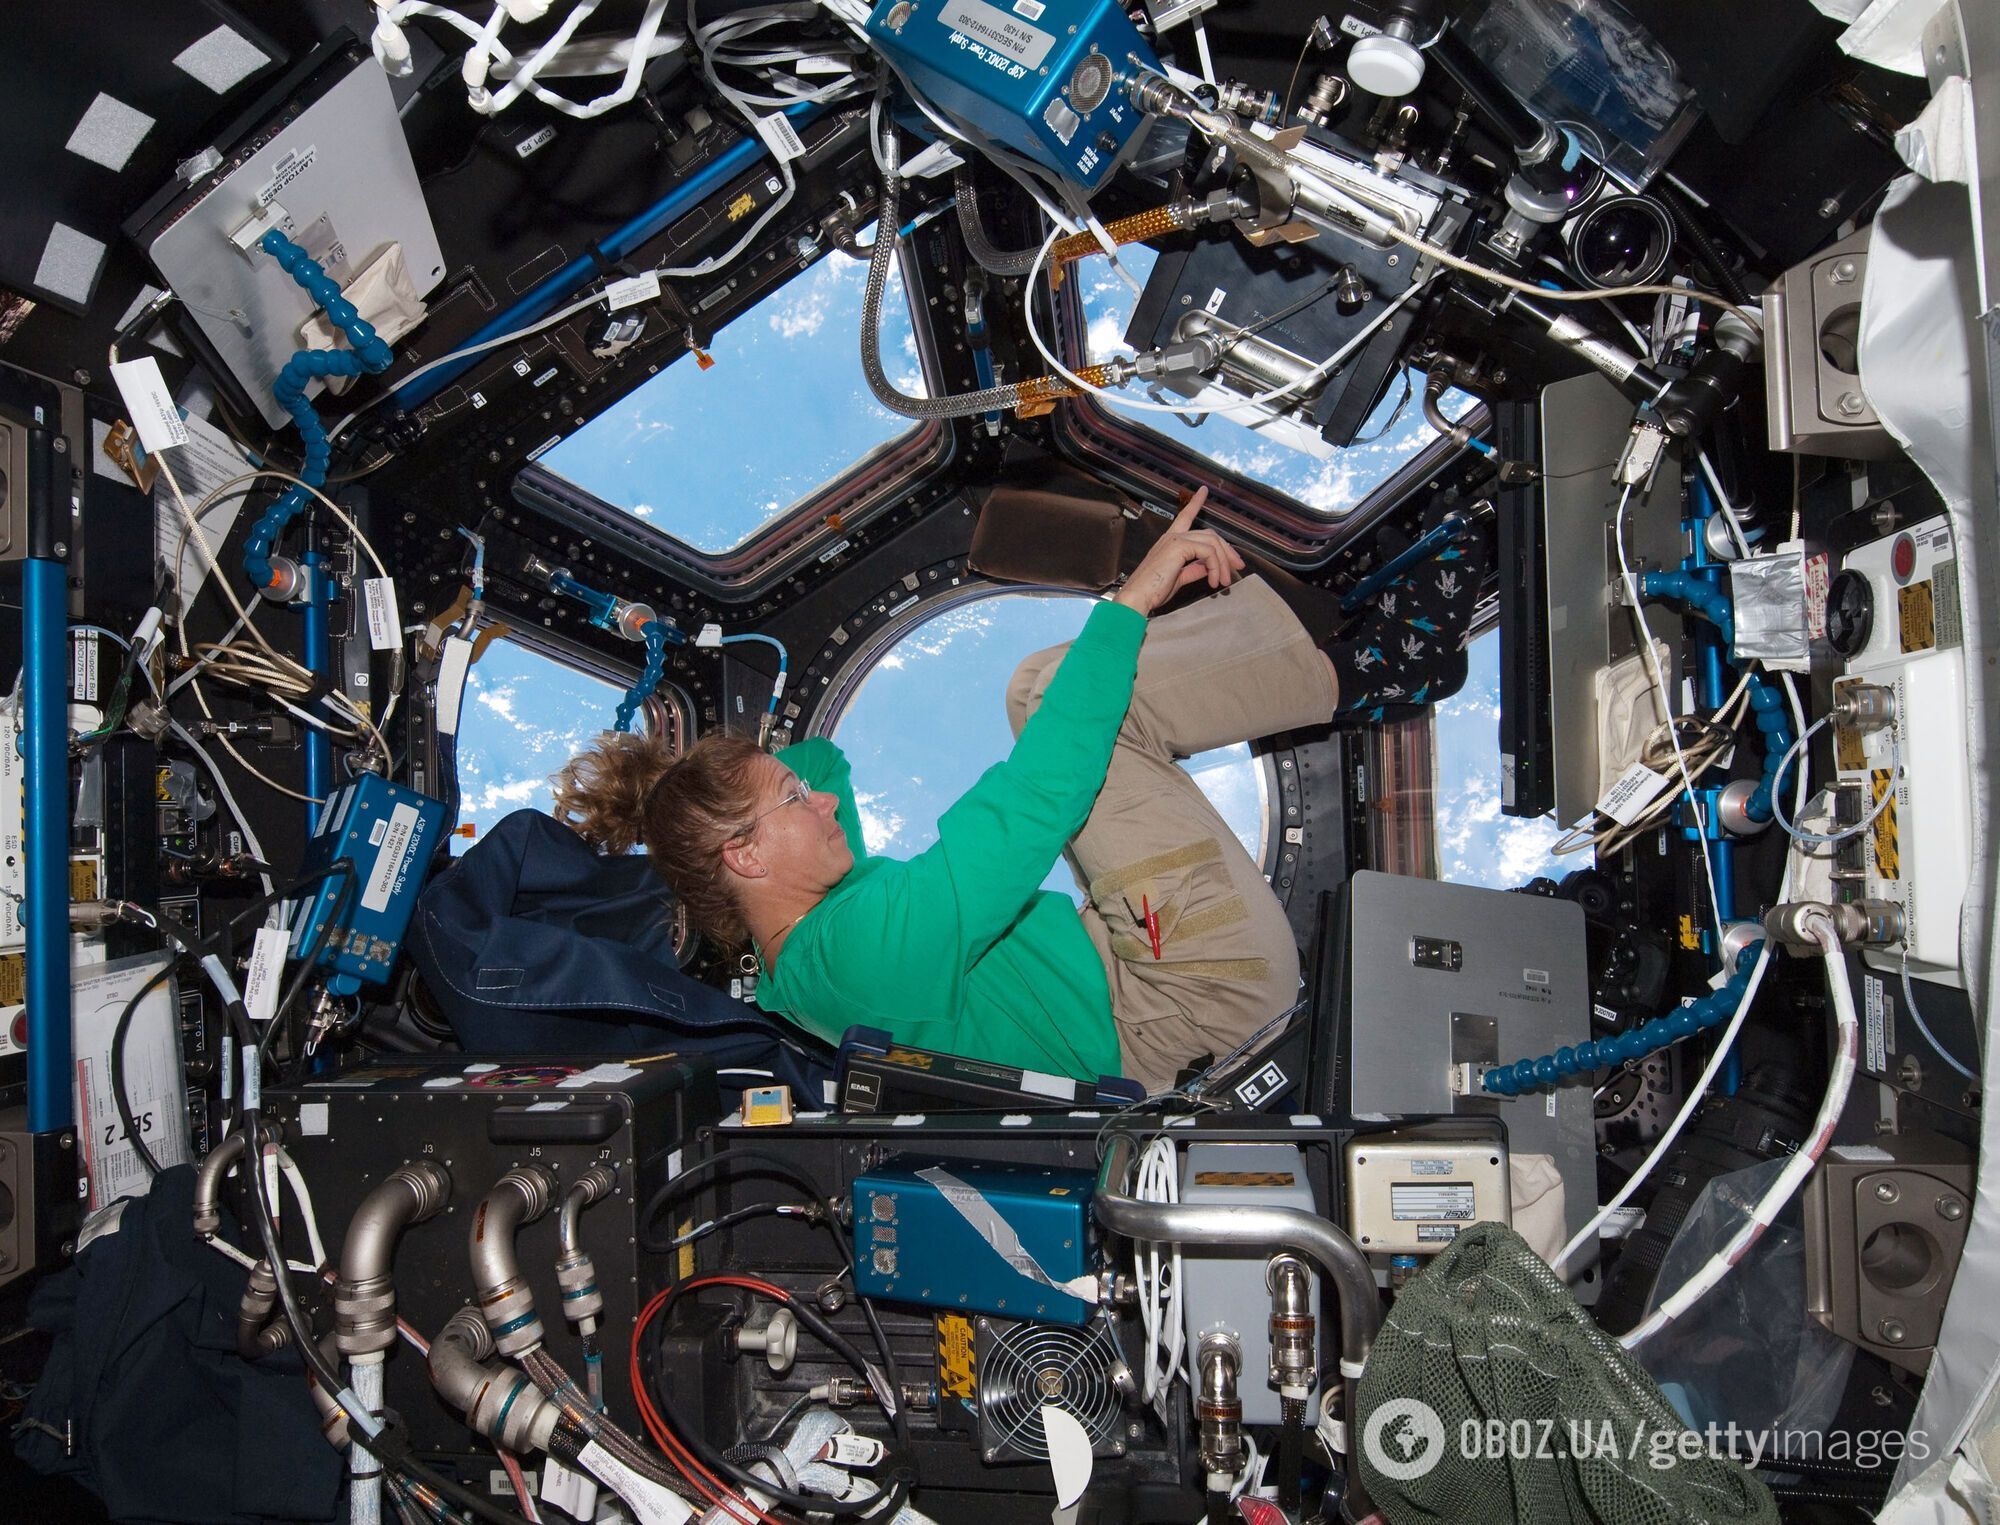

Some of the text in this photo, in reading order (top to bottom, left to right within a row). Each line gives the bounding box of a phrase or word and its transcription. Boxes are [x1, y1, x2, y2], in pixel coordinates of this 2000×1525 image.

[946, 29, 971, 49] Supply
[957, 14, 1025, 53] P/N SEG33116412-303
[1003, 23, 1032, 42] S/N 1430
[965, 41, 987, 59] Power
[282, 156, 312, 185] LAPTOP
[261, 182, 282, 203] DESK
[767, 177, 781, 192] C
[514, 360, 528, 375] G
[1901, 595, 1911, 643] CAUTION
[87, 649, 95, 680] Support
[356, 674, 367, 684] C
[386, 821, 400, 848] S/N 1421
[379, 824, 408, 892] P/N SEG33116412-303
[400, 856, 412, 874] Power
[12, 869, 17, 878] J5
[390, 874, 405, 895] Supply
[850, 1083, 870, 1091] EMS
[102, 1111, 155, 1145] SE 2
[422, 1144, 433, 1153] J3
[529, 1147, 541, 1156] J5
[598, 1149, 609, 1158] J7
[587, 1444, 597, 1455] TO
